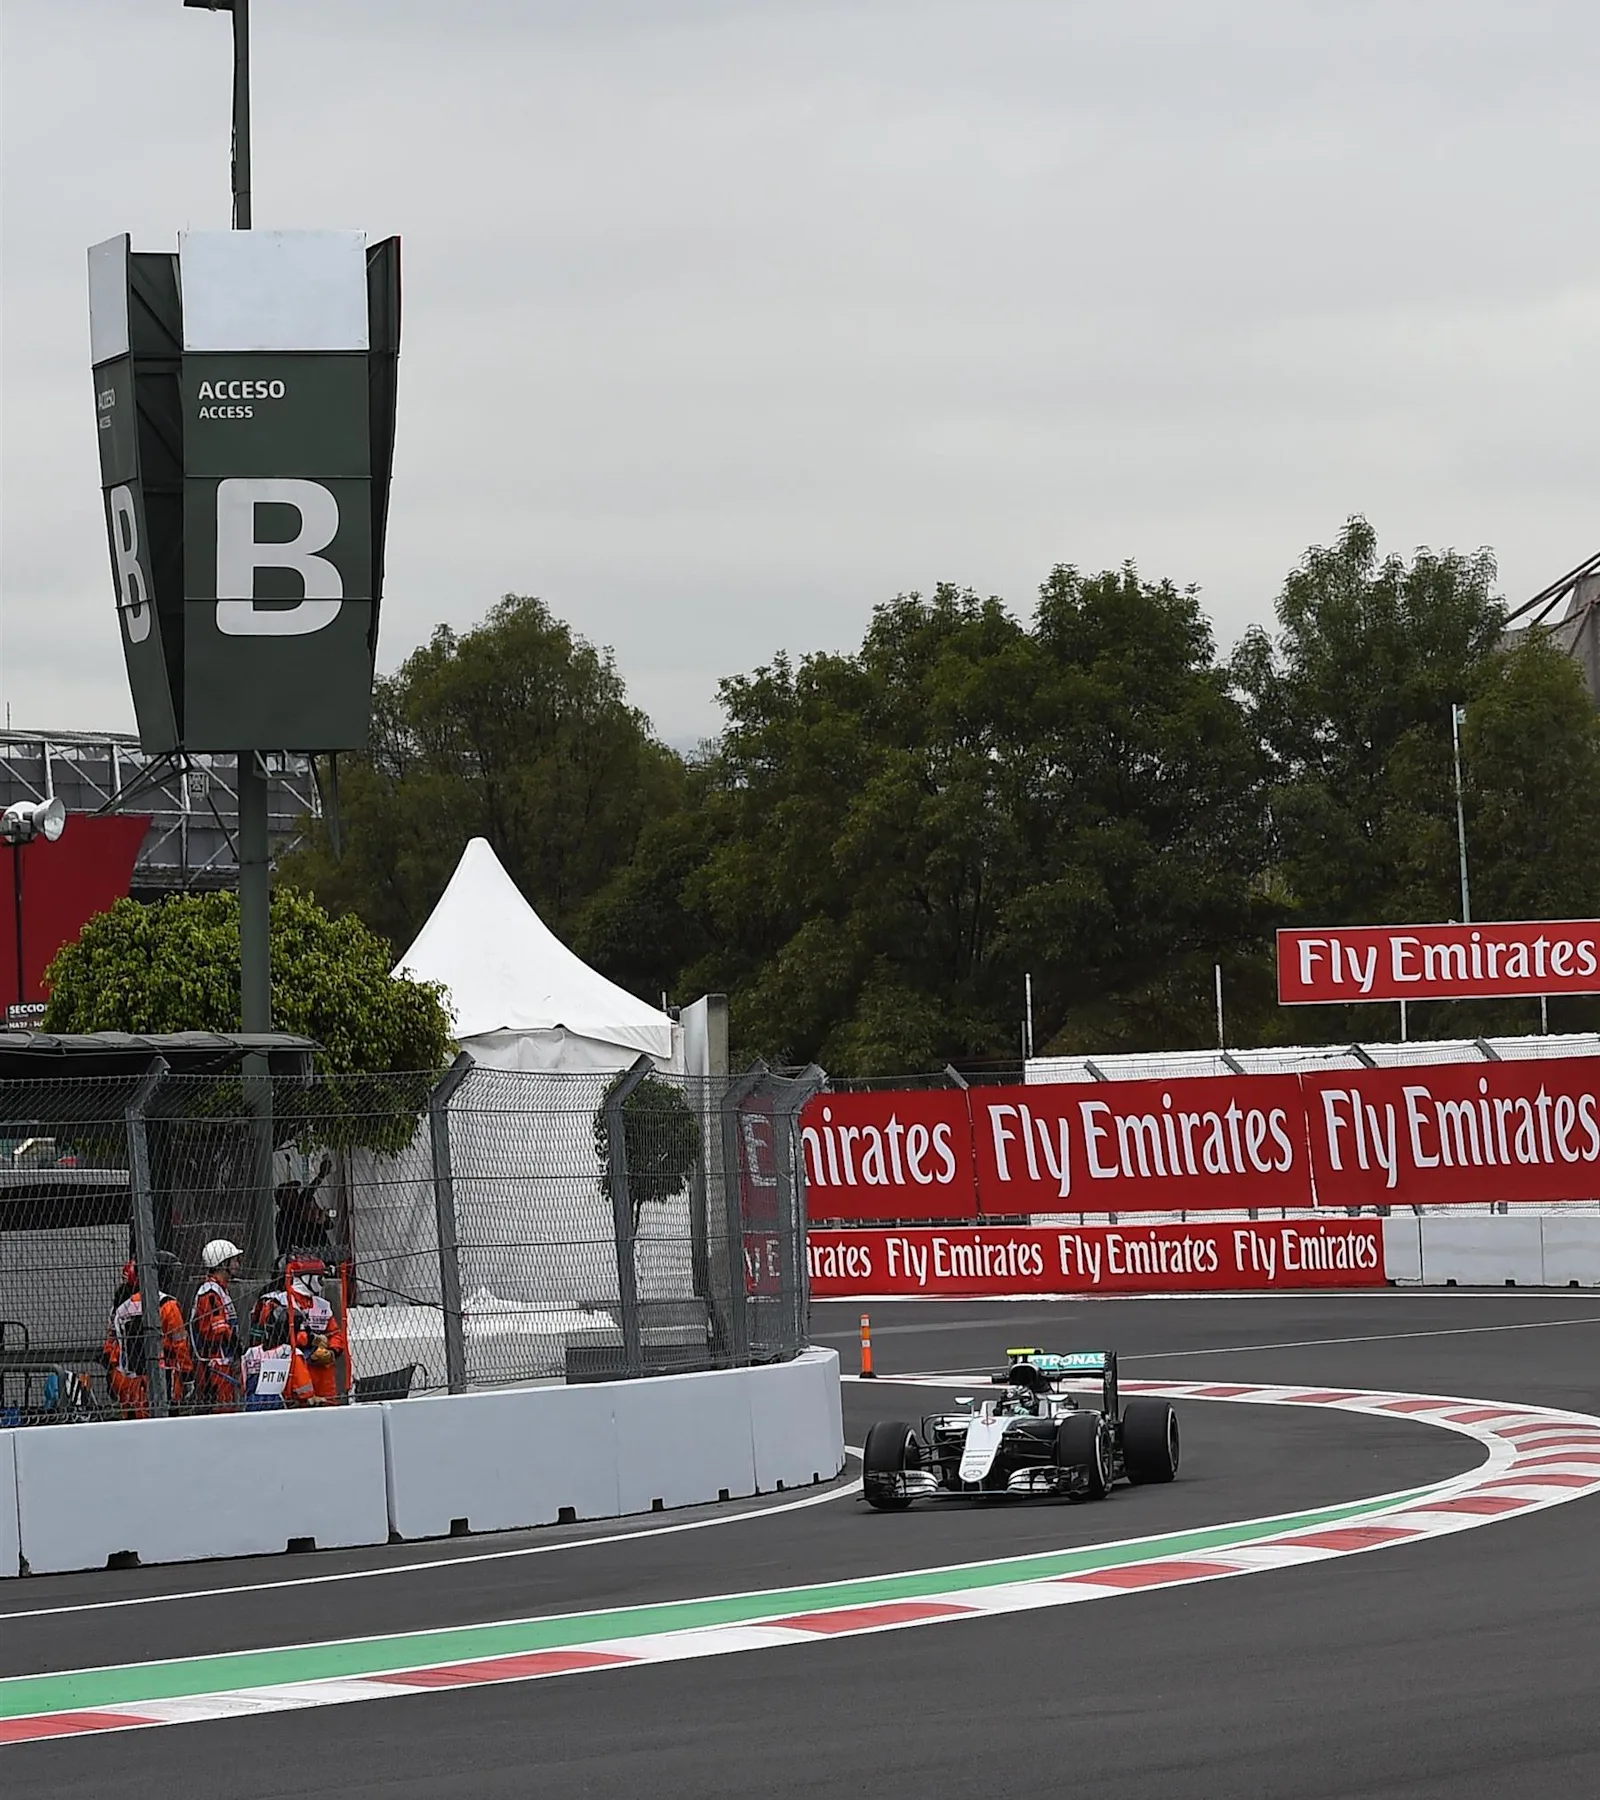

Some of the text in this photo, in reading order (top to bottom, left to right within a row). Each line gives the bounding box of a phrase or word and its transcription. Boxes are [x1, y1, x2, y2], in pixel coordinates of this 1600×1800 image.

[198, 380, 285, 400] ACCESO
[198, 405, 254, 419] ACCESS
[110, 484, 152, 643] B
[216, 478, 344, 636] B
[1297, 932, 1598, 993] Fly Emirates
[988, 1093, 1293, 1198] Fly Emirates
[1319, 1077, 1600, 1188] Fly Emirates
[886, 1235, 1044, 1286] Fly Emirates
[1057, 1231, 1218, 1284] Fly Emirates
[1234, 1226, 1378, 1280] Fly Emirates
[262, 1371, 287, 1383] PIT IN
